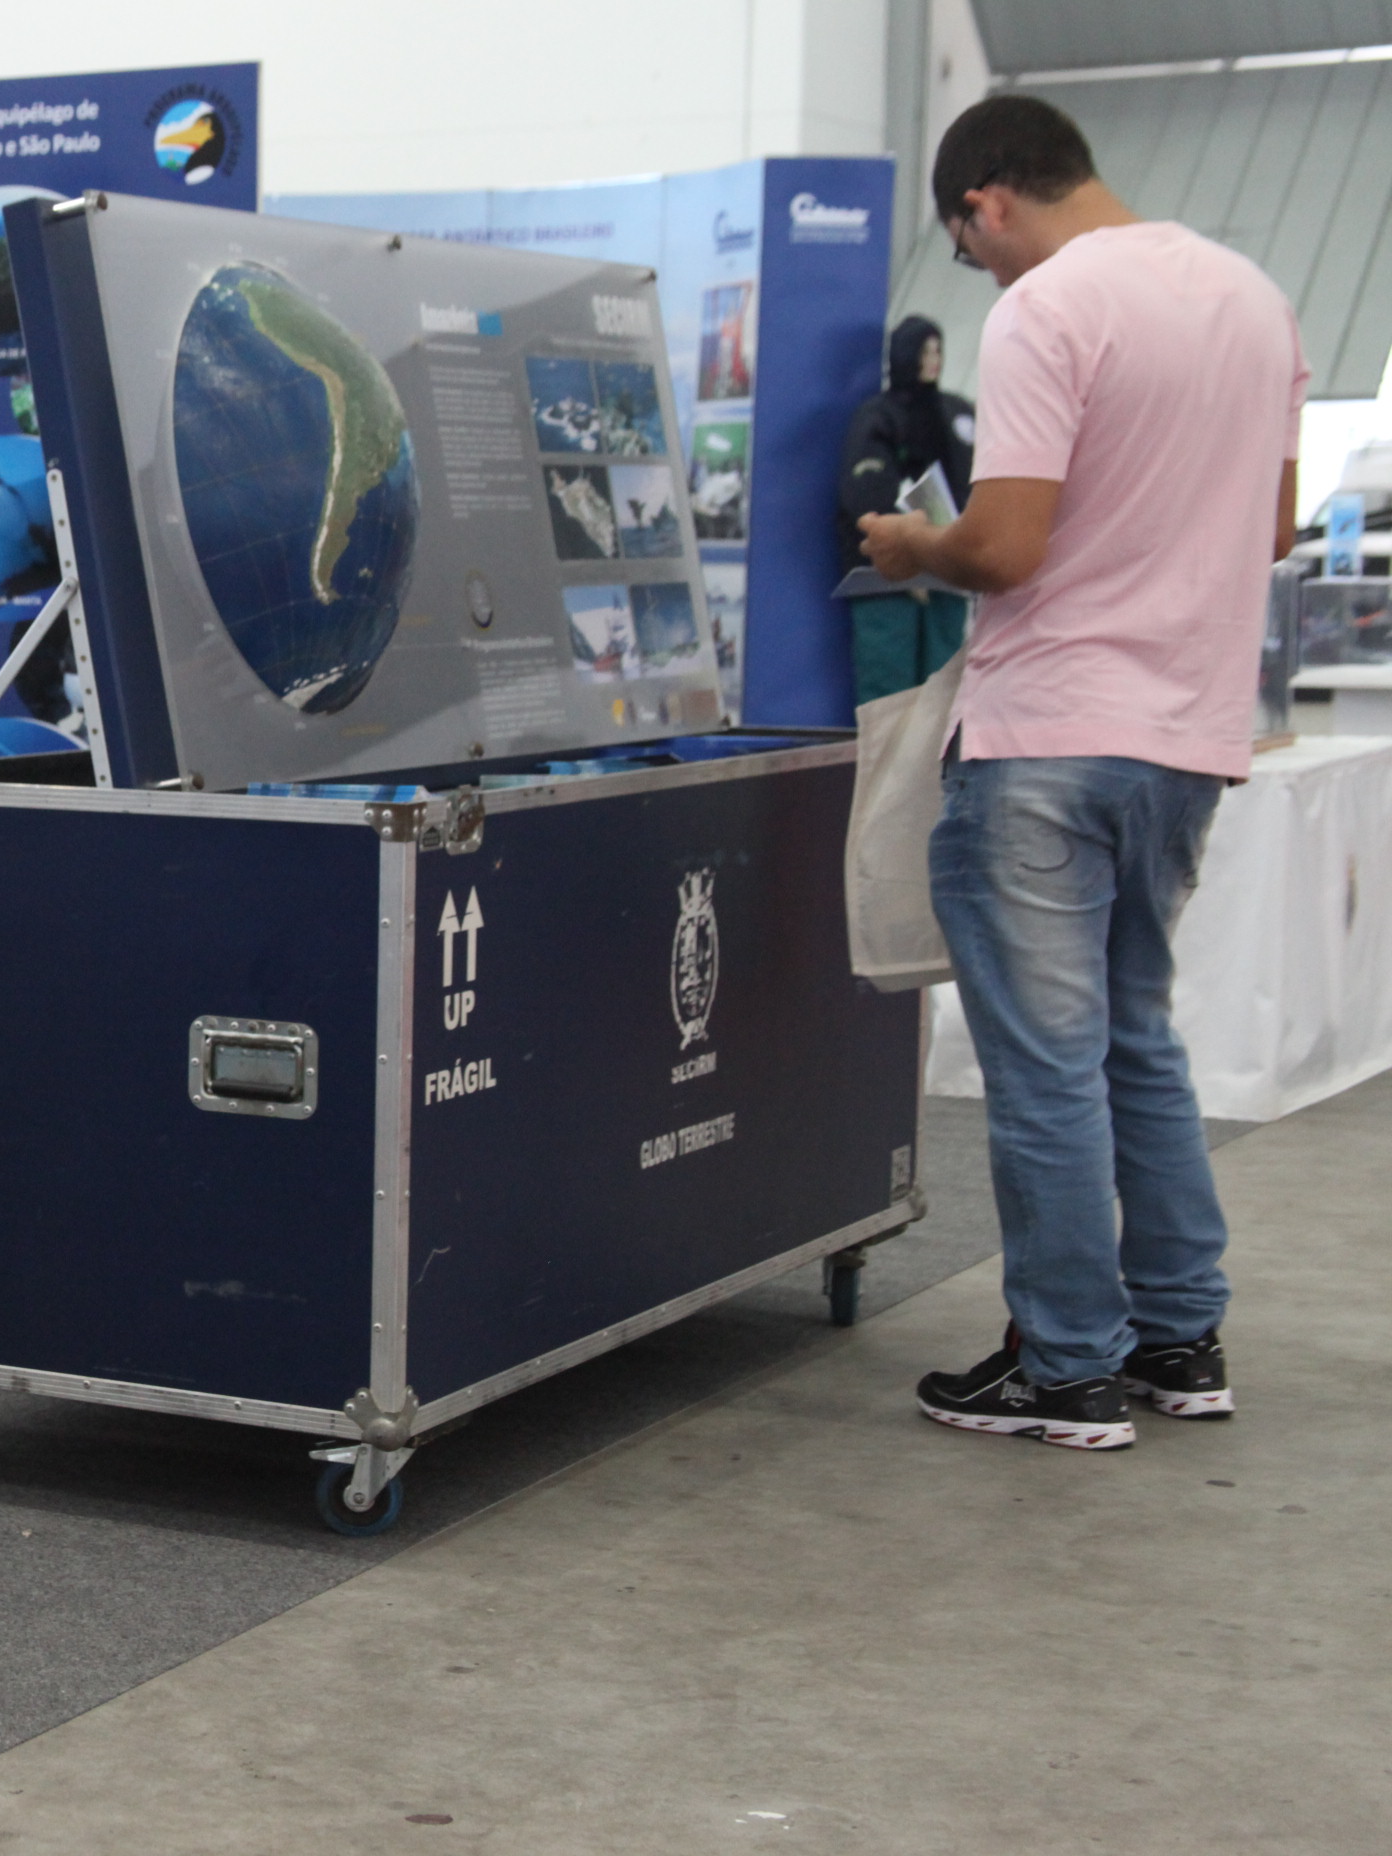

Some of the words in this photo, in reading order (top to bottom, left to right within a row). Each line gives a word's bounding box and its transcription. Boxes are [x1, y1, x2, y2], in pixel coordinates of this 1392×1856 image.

[76, 98, 100, 121] de
[5, 139, 17, 157] e
[18, 134, 51, 157] São
[52, 131, 101, 154] Paulo
[444, 990, 475, 1031] UP
[425, 1058, 497, 1106] FRÁGIL
[640, 1131, 677, 1170] GLOBO
[678, 1111, 736, 1156] TERRESTRE
